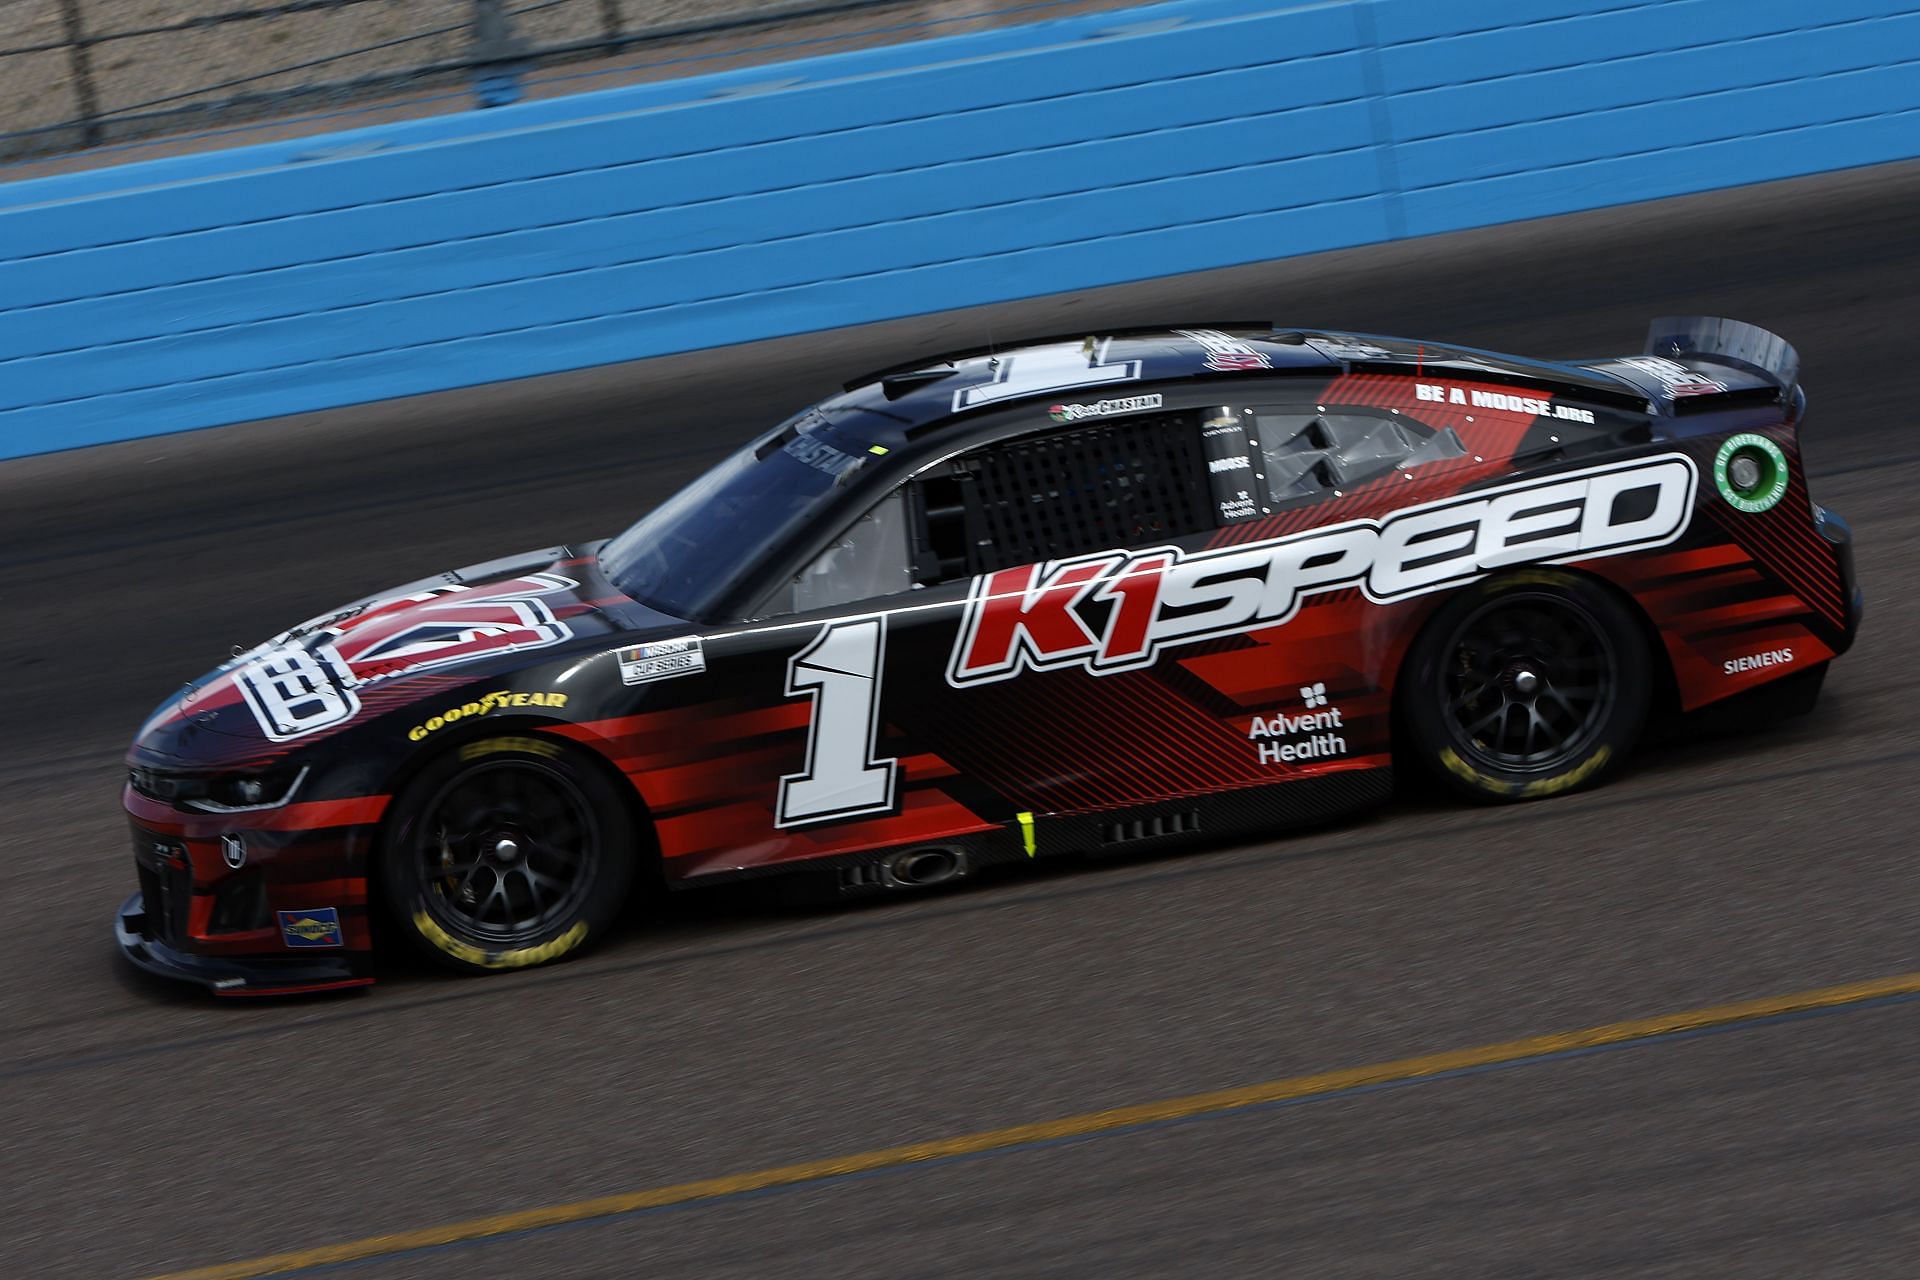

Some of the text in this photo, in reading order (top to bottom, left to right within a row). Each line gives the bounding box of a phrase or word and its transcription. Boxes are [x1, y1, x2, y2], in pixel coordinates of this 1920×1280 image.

[1415, 384, 1595, 425] BE A MOOSE.ORG
[632, 655, 692, 675] CUP SERIES
[1723, 647, 1794, 675] SIEMENS
[408, 690, 568, 741] GOODYEAR
[774, 612, 897, 829] 1
[1248, 707, 1344, 740] Advent
[1258, 733, 1347, 765] Health
